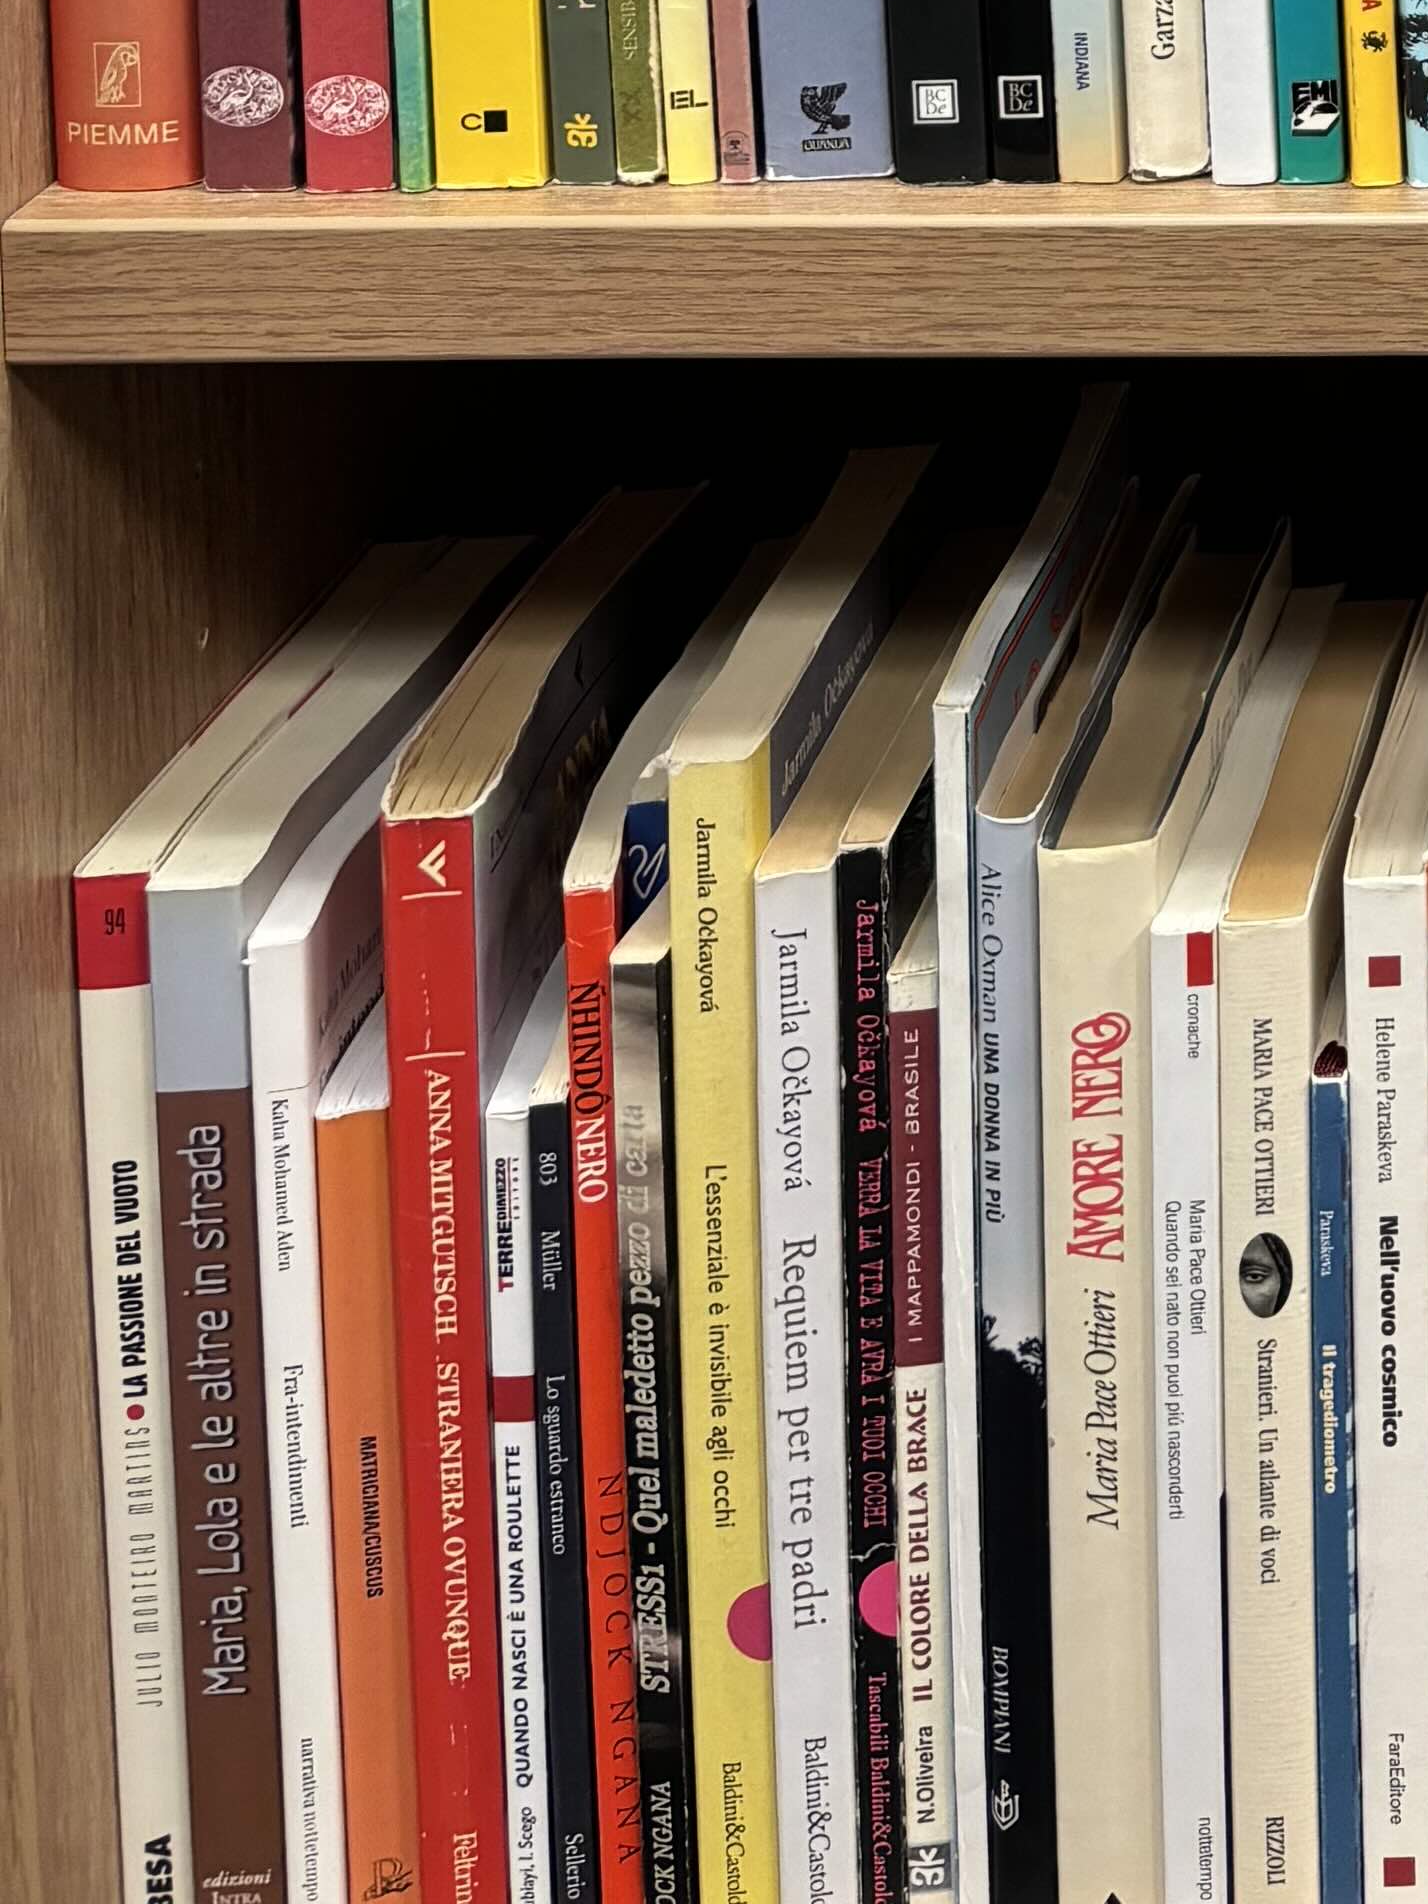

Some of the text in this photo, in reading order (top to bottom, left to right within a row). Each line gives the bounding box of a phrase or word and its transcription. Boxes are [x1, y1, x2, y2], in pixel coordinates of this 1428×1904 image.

[425, 1070, 458, 1340] ANNA MITGUTSCH
[1253, 1018, 1275, 1216] MARIA PACE OTTIERI
[437, 1363, 470, 1681] STRANIERA OVUNQUE
[775, 1234, 829, 1629] Requiem per tre padri
[1381, 1344, 1403, 1447] cosmico
